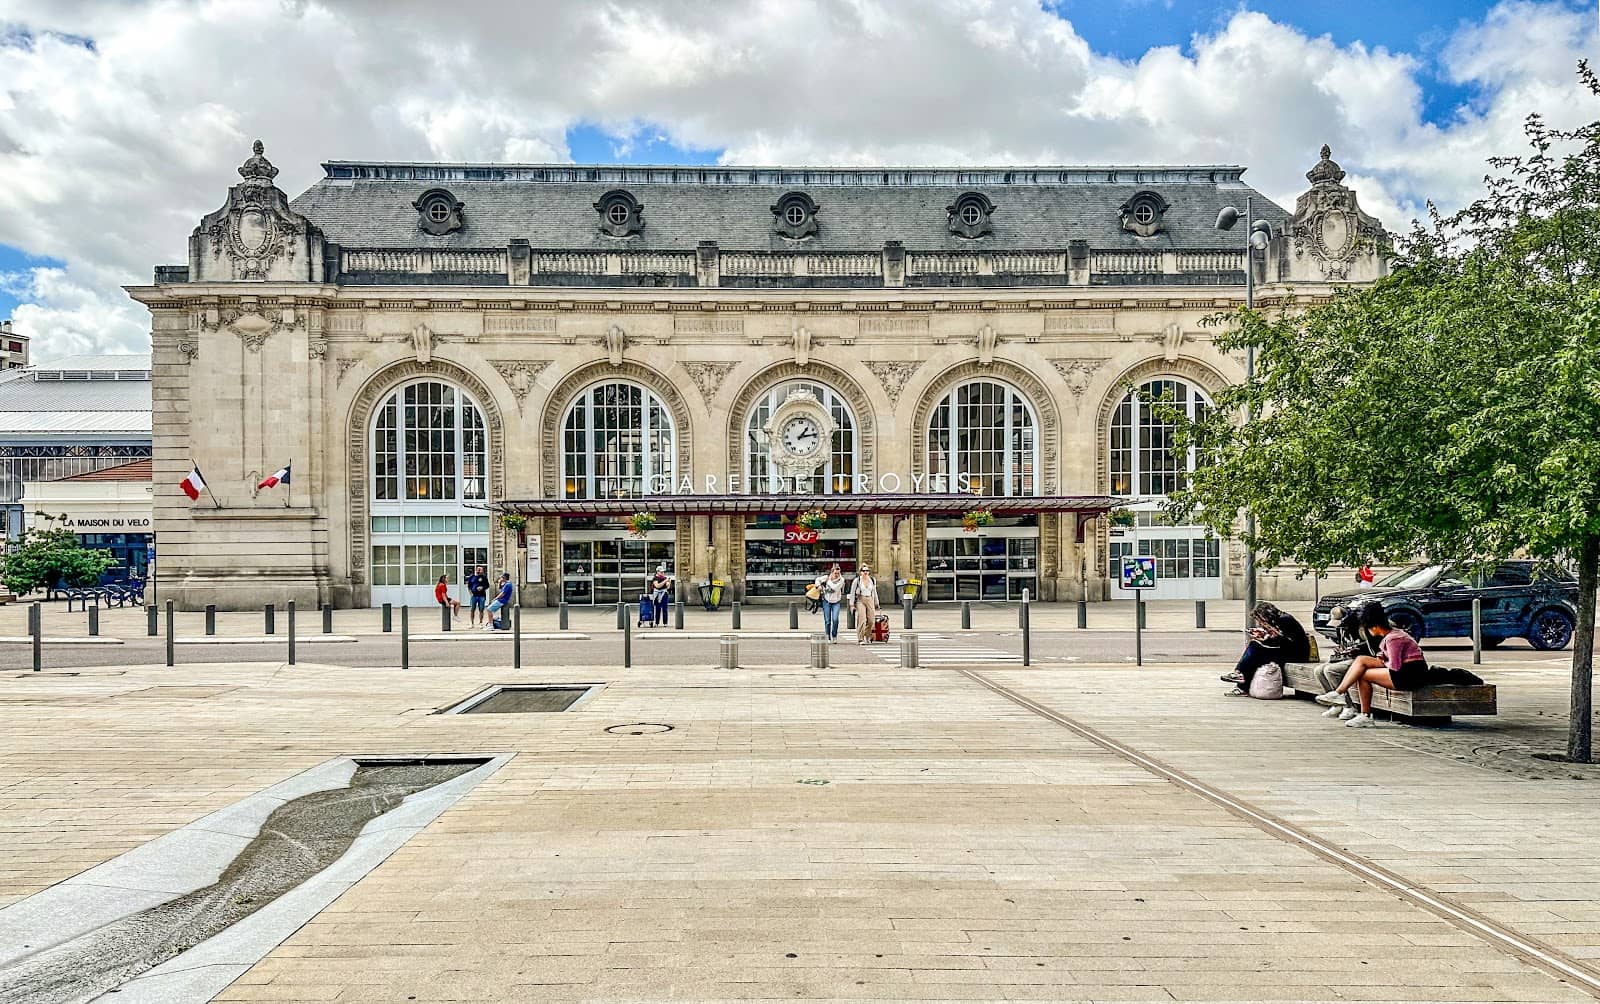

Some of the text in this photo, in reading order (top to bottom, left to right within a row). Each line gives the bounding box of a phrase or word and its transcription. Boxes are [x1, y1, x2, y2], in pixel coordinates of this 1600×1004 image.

[648, 472, 971, 495] GARE DE TROYES
[63, 518, 150, 527] LA MAISON DU VELO
[785, 531, 817, 542] SNCF
